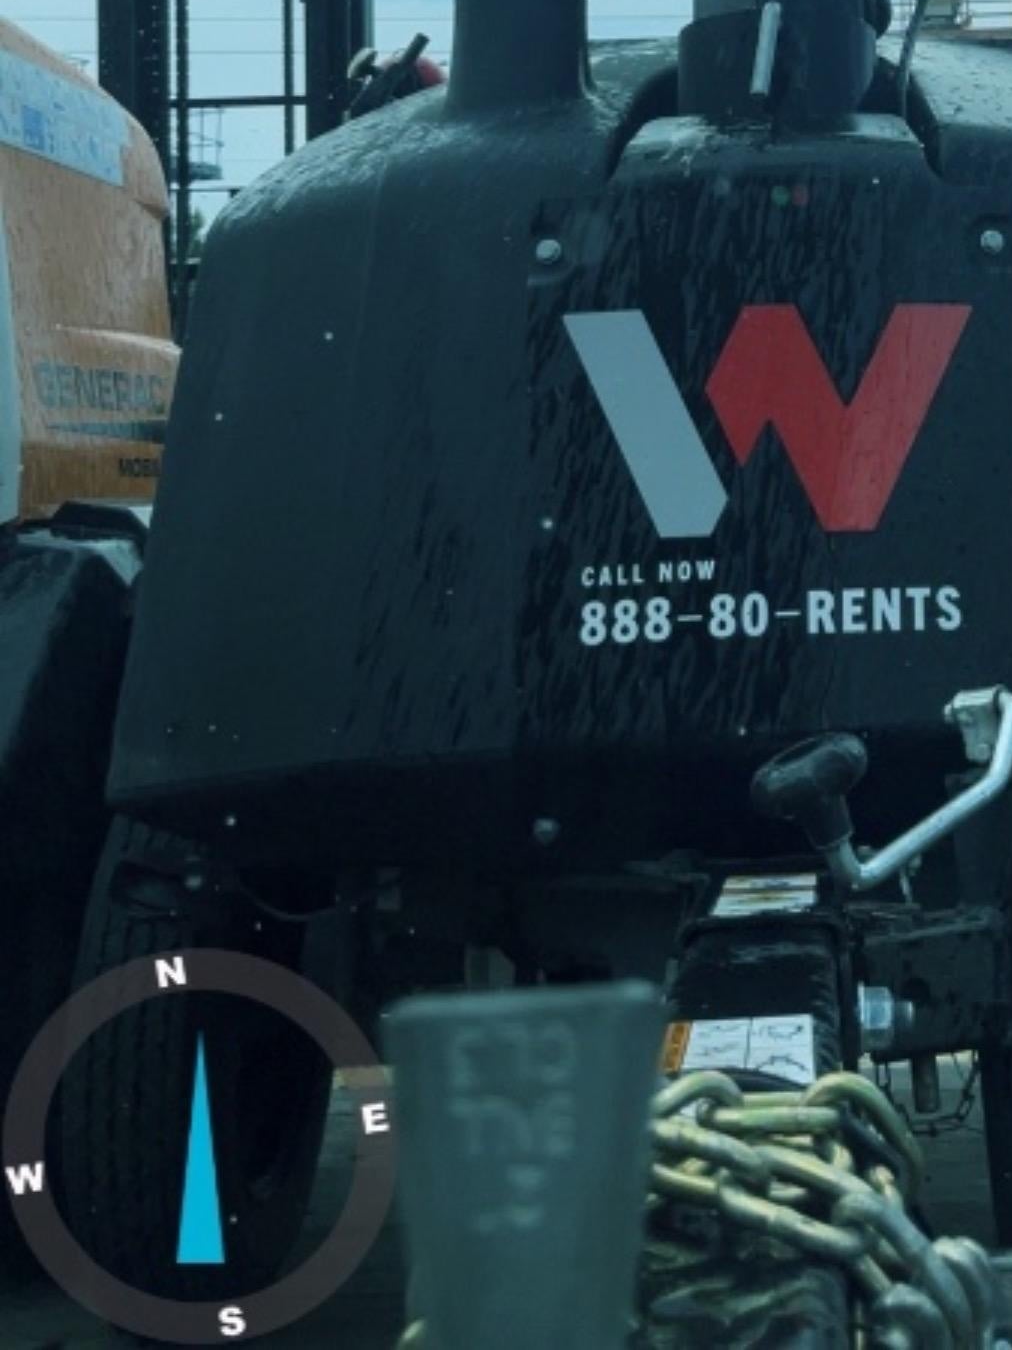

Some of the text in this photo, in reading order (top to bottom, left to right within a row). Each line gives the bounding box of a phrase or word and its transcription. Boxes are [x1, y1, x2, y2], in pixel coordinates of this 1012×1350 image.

[581, 560, 716, 586] CALL NOW
[580, 585, 963, 646] 888-80-RENTS
